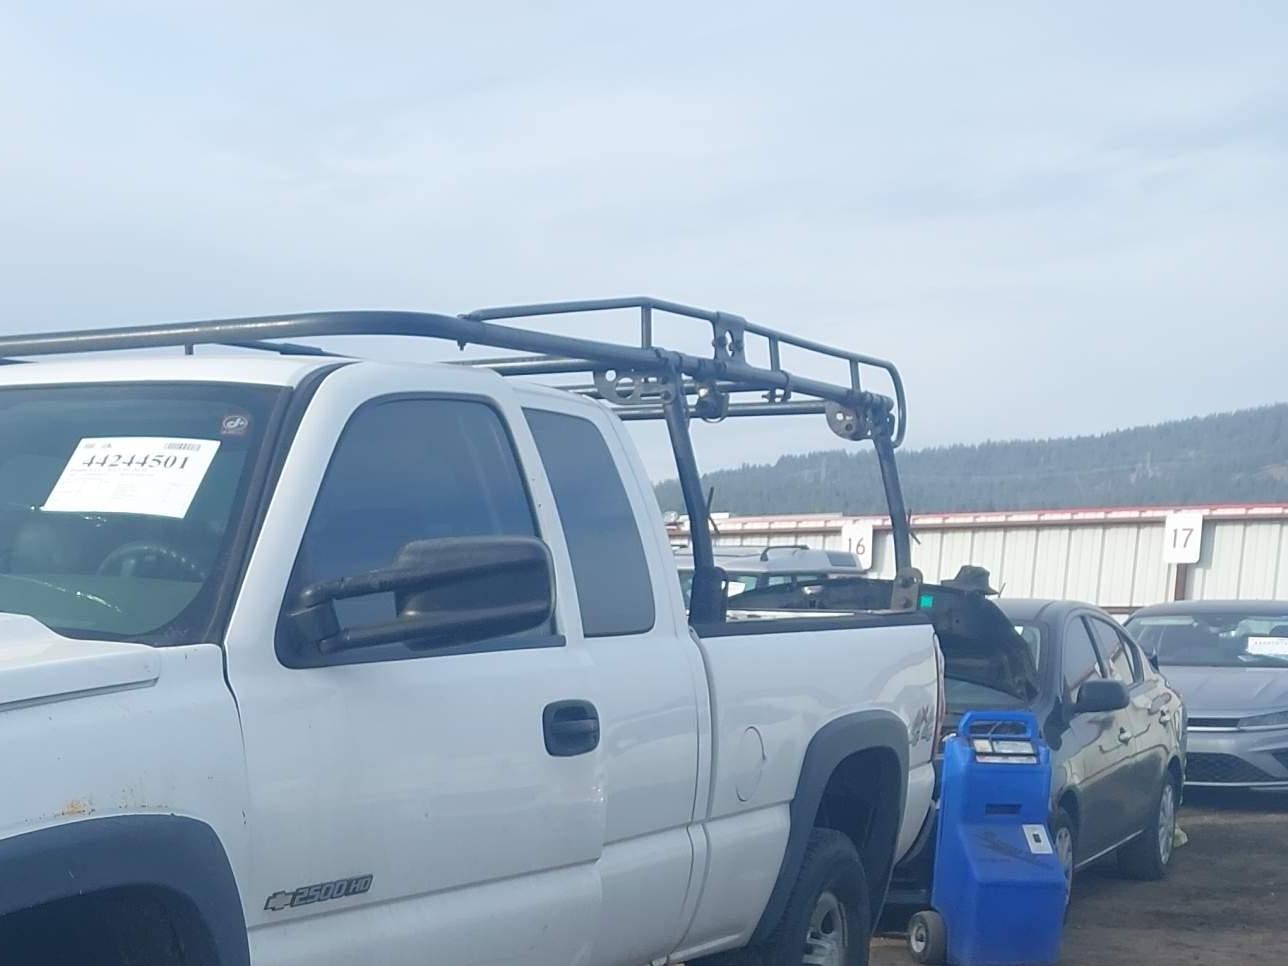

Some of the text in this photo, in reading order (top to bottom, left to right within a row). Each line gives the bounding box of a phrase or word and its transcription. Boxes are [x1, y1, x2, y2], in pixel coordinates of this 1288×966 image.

[82, 454, 189, 469] 44244501
[848, 537, 866, 555] 16
[1172, 528, 1194, 549] 17
[293, 877, 372, 905] 2500 HD
